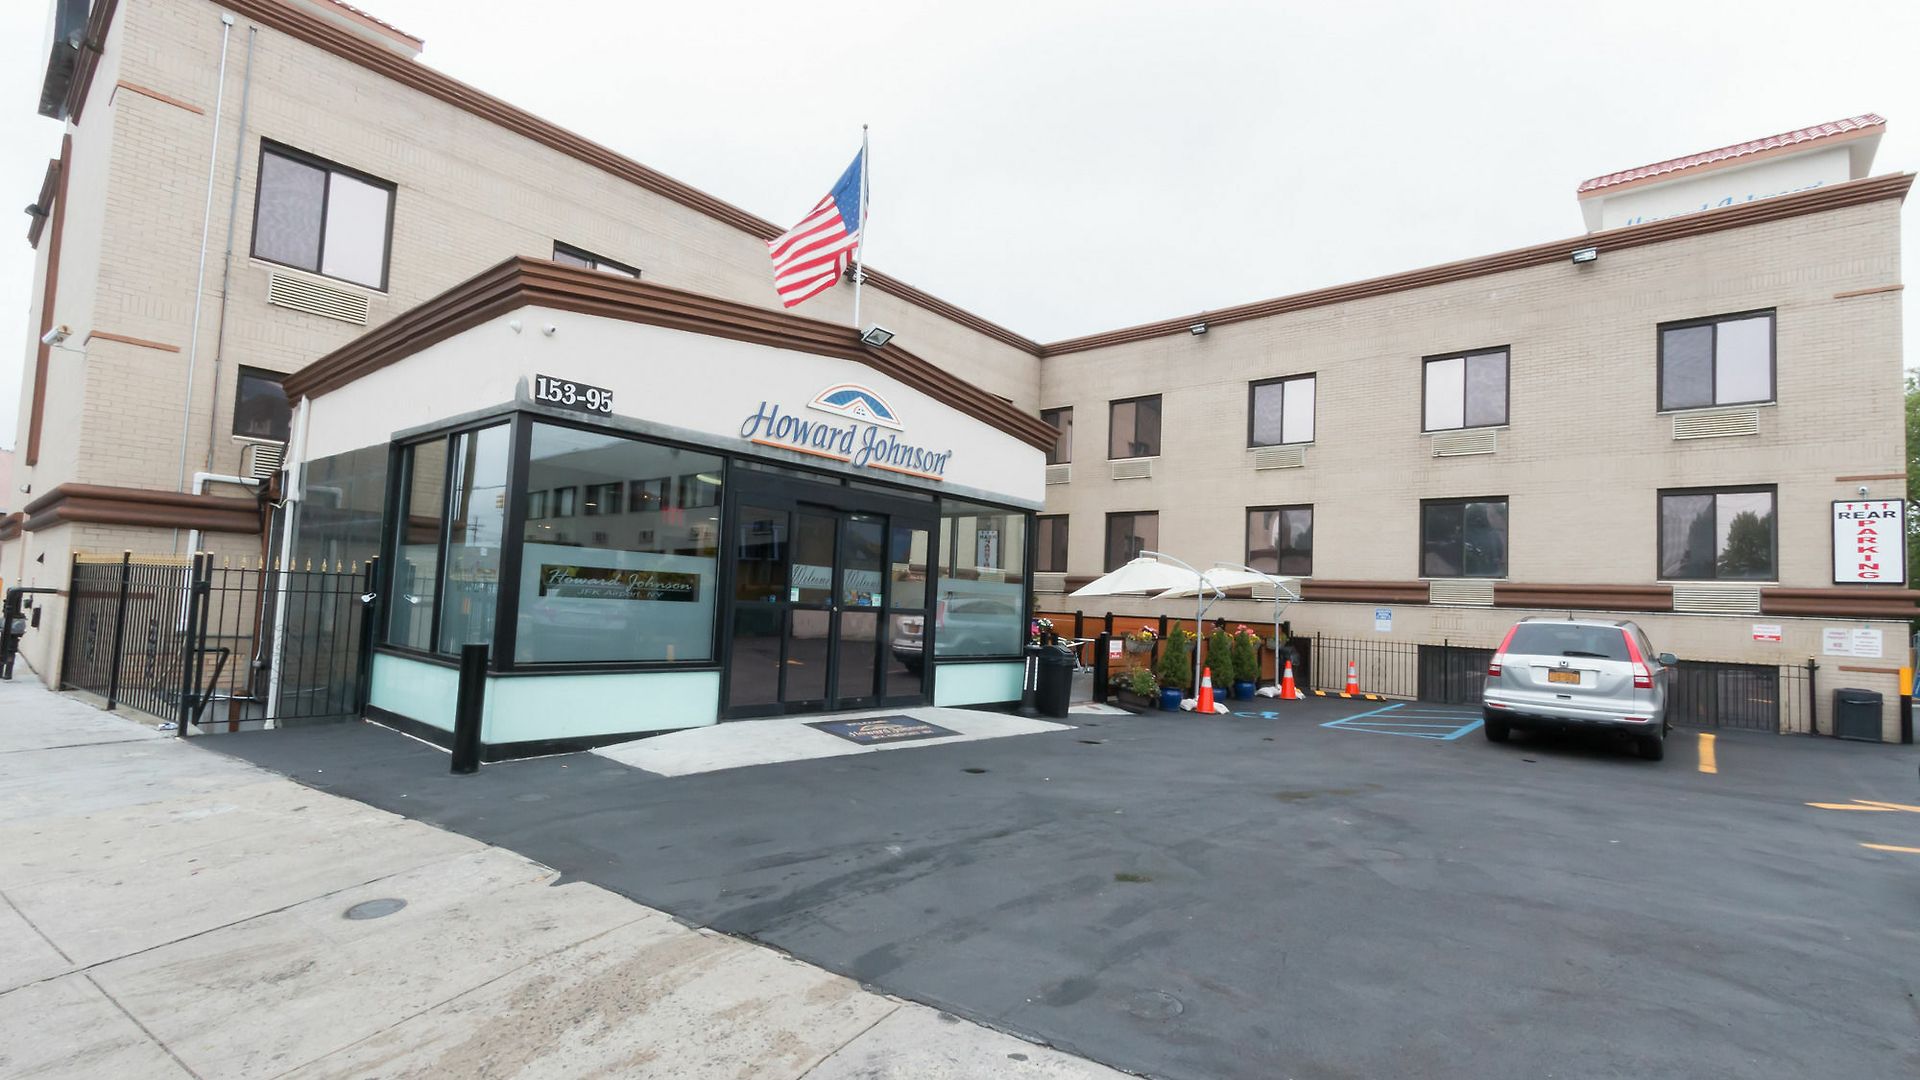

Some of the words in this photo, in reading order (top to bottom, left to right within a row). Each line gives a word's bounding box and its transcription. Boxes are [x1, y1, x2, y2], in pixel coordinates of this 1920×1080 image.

[536, 377, 612, 413] 153-95
[741, 401, 855, 454] Howard
[854, 425, 952, 475] Johnson
[1838, 510, 1897, 519] REAR
[1857, 520, 1880, 579] PARKING
[547, 569, 621, 587] Howard
[626, 574, 692, 592] Johnson
[577, 588, 600, 597] JFK
